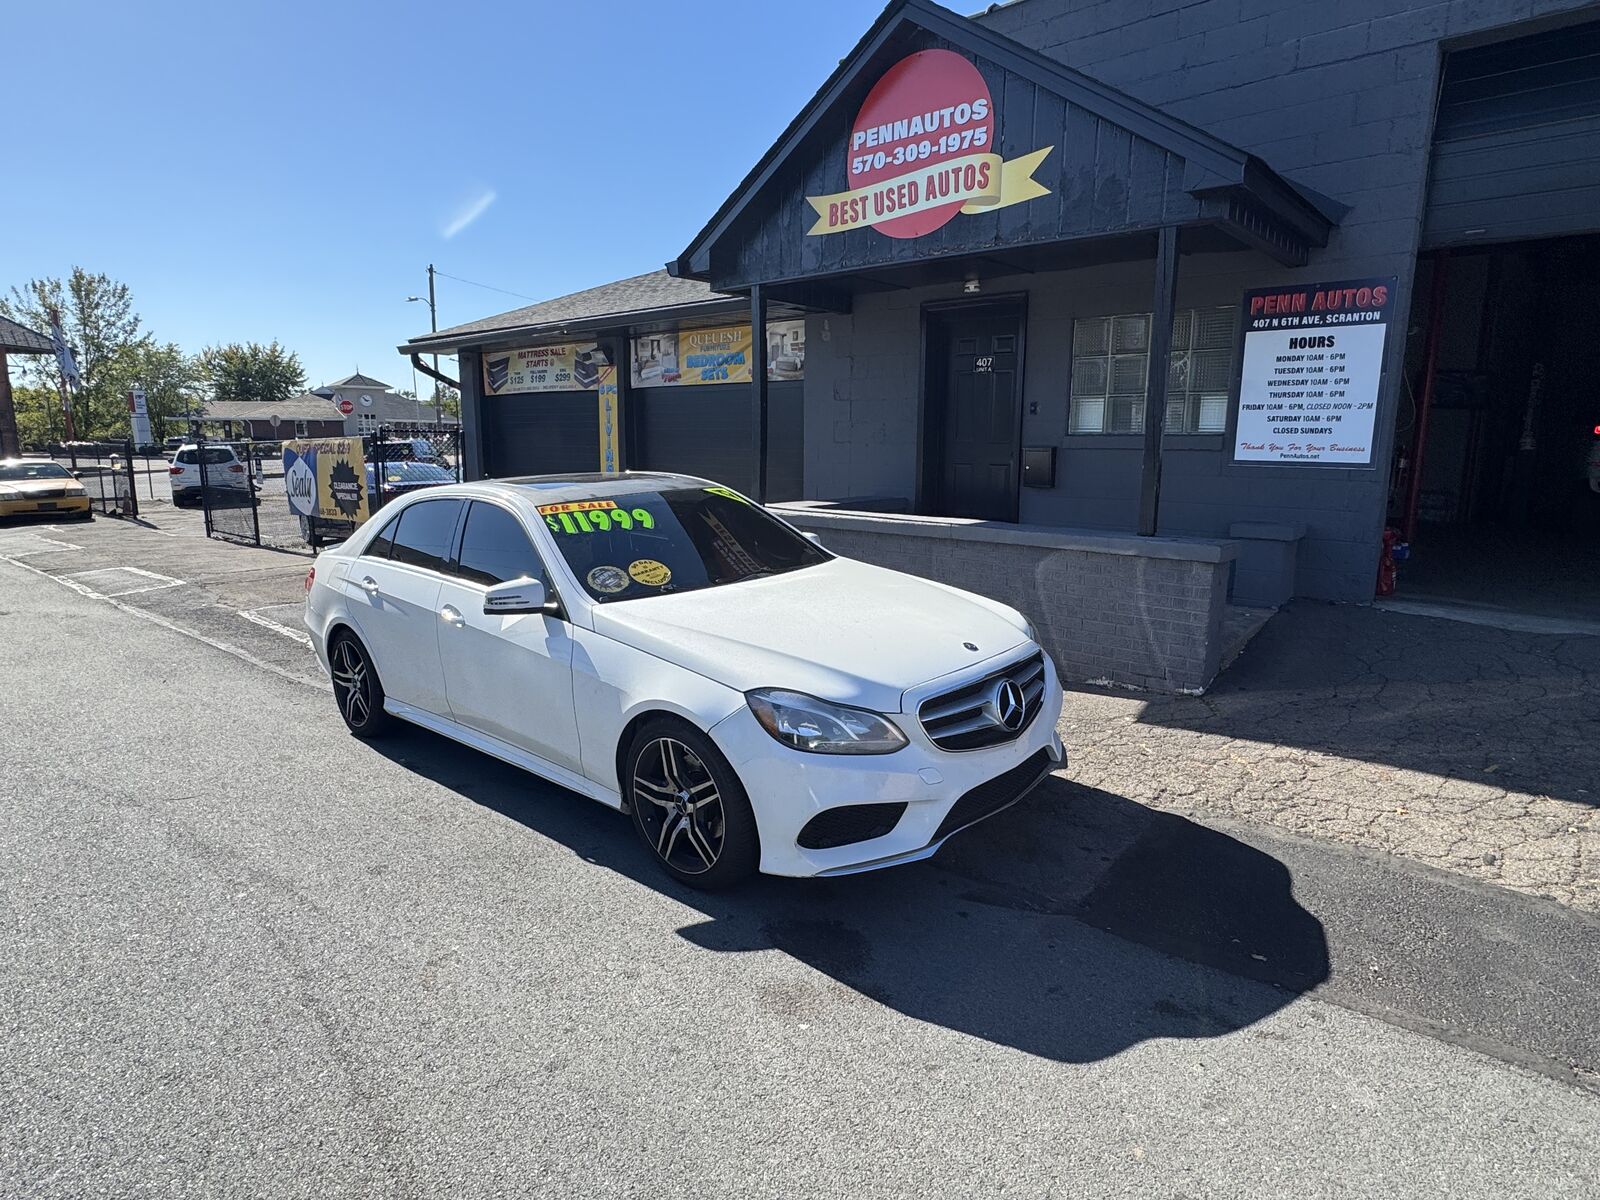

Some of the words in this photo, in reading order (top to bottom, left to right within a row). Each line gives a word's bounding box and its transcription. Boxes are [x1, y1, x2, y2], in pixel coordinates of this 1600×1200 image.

[853, 98, 988, 151] PENNAUTOS
[852, 127, 988, 174] 570-309-1975
[828, 195, 868, 227] BEST
[874, 180, 919, 216] USED
[924, 162, 990, 201] AUTOS
[1250, 292, 1306, 316] PENN
[1312, 286, 1388, 311] AUTOS
[1252, 318, 1270, 328] 407
[1272, 318, 1279, 326] N
[1281, 317, 1299, 326] 6TH
[1302, 315, 1323, 325] AVE,
[1326, 312, 1380, 324] SCRANTON
[1289, 336, 1335, 349] HOURS
[518, 349, 549, 359] MATTRESS
[550, 348, 566, 356] SALE
[687, 352, 745, 368] BEDROOM
[526, 360, 548, 368] STARTS
[976, 358, 992, 366] 407
[555, 374, 570, 382] $299
[701, 367, 728, 380] SETS
[1268, 443, 1284, 452] You
[1306, 444, 1325, 453] Your
[1330, 444, 1365, 452] Business
[290, 470, 312, 504] Sealy
[334, 482, 358, 490] CLEARANCE
[541, 504, 569, 513] FOR
[578, 501, 616, 510] SALE
[546, 508, 654, 534] $11999
[632, 566, 664, 576] WARRANTY
